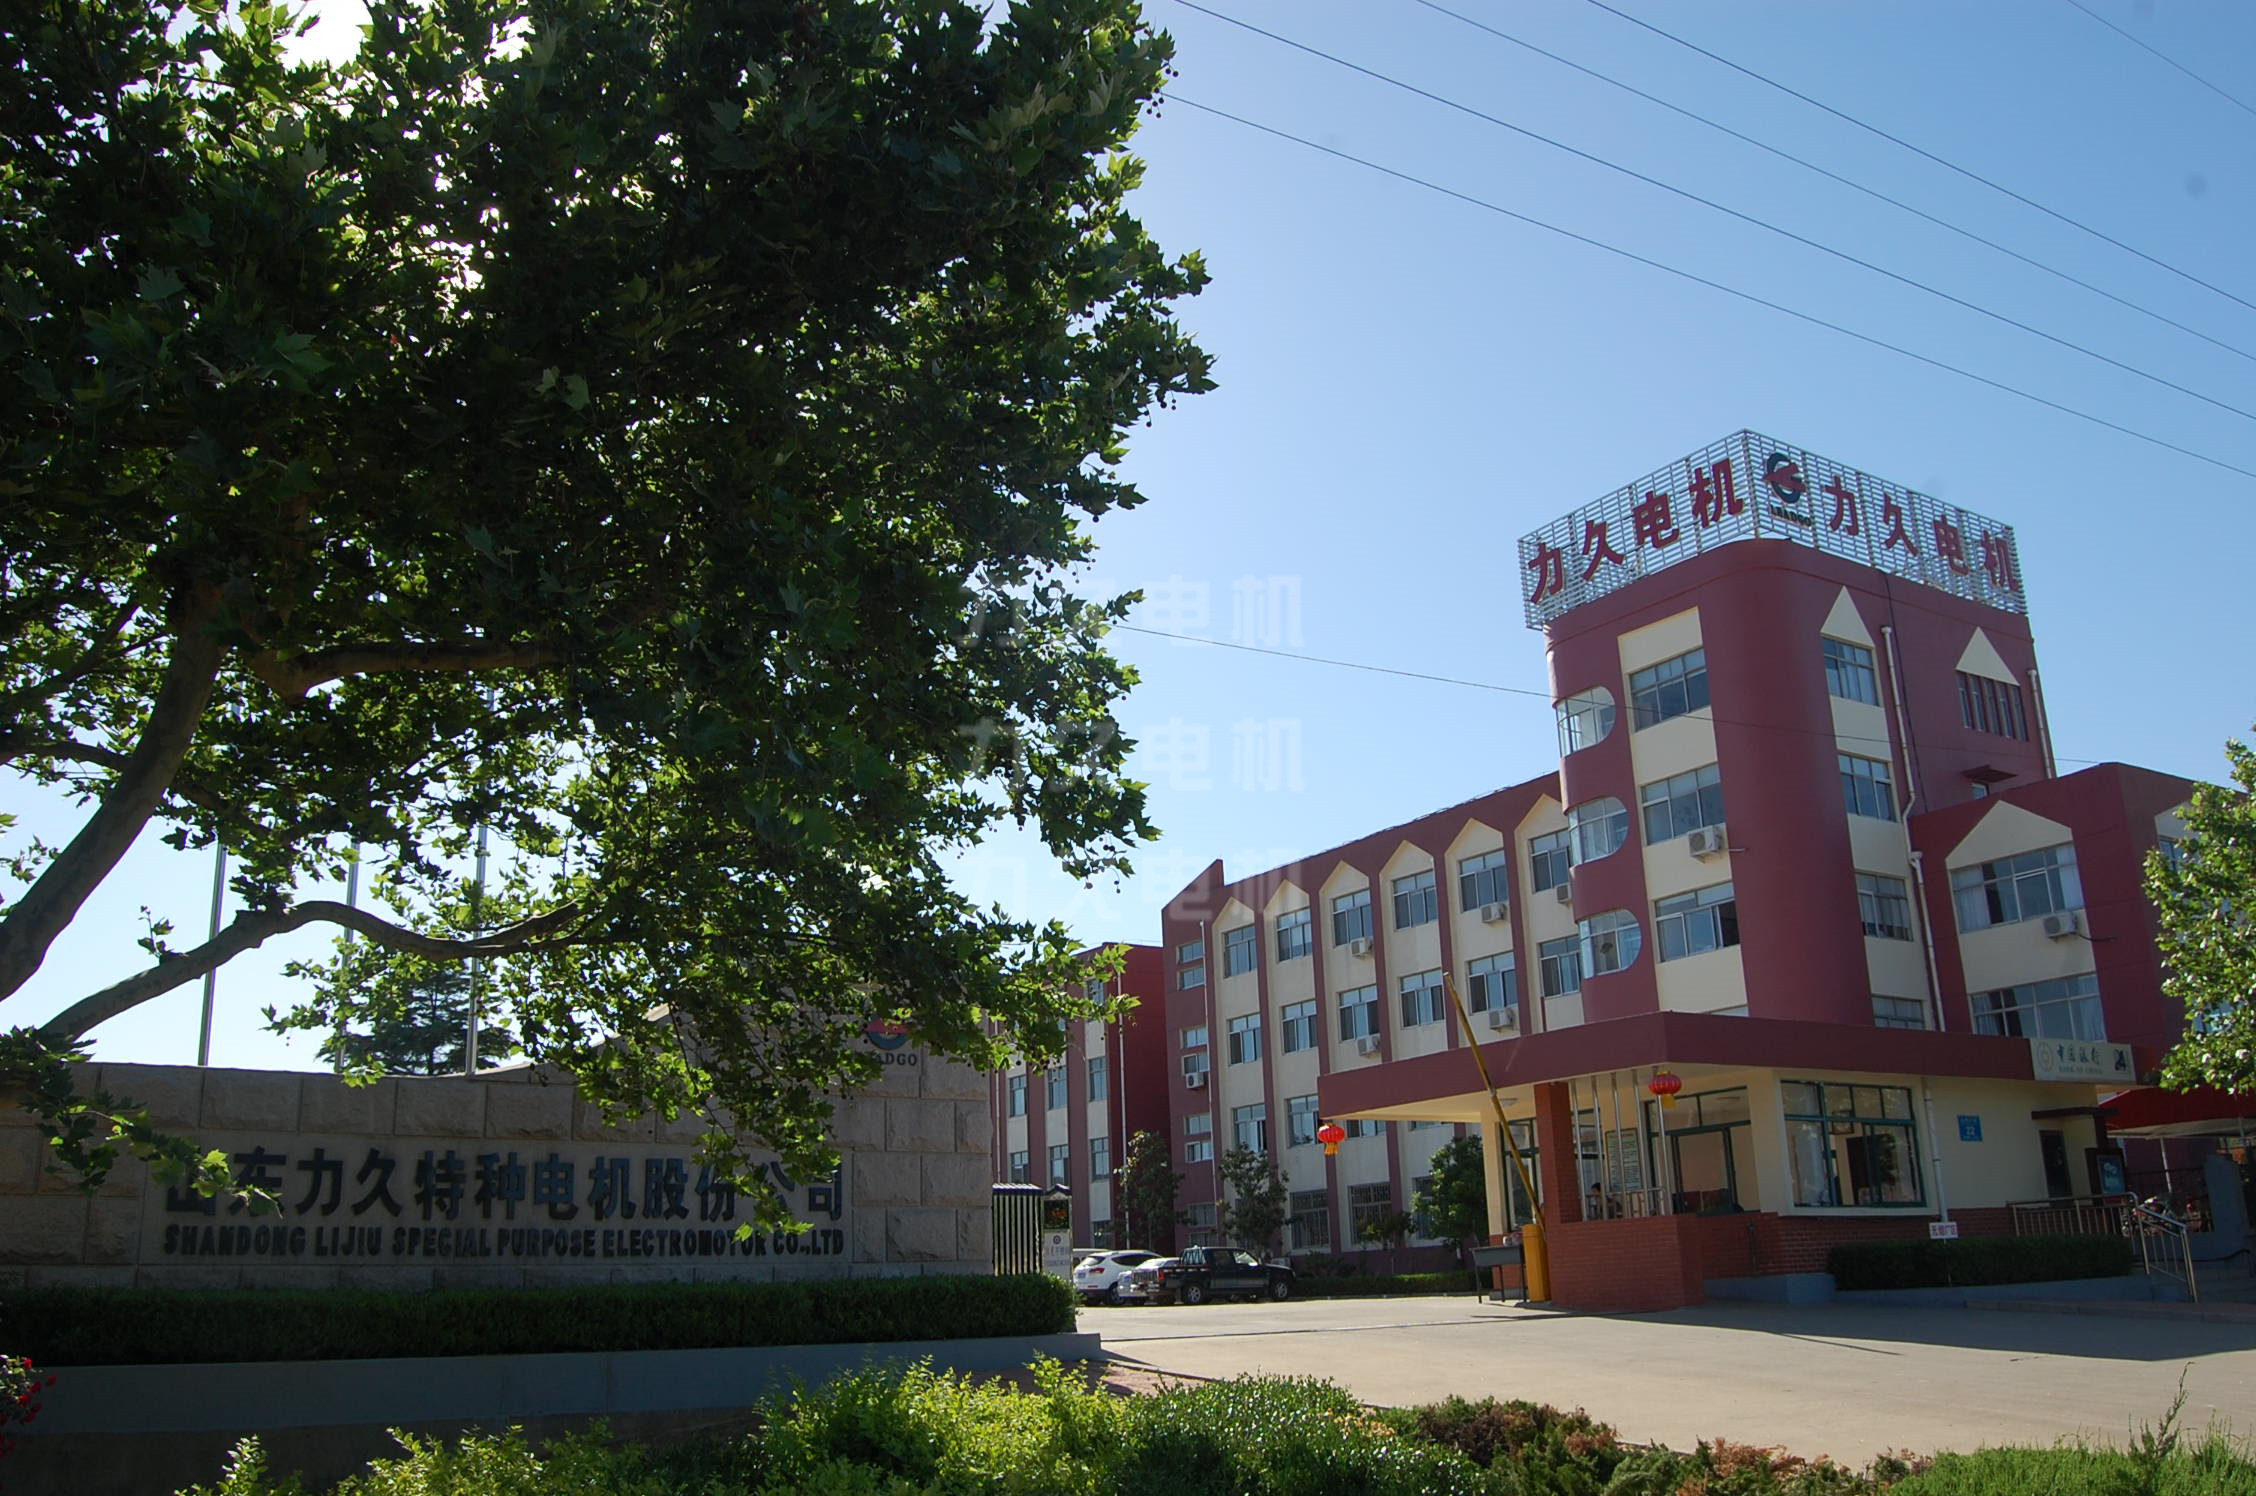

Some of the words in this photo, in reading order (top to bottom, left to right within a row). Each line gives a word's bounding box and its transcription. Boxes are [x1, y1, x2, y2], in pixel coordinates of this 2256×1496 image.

[1528, 458, 1744, 604] 力久电机
[1769, 504, 1812, 527] LEADGO
[1823, 476, 2021, 592] 力久电机
[875, 1052, 918, 1066] ADGO
[164, 1224, 306, 1257] SHANDONG
[315, 1226, 382, 1256] LIJIU
[392, 1227, 491, 1258] SPECIAL
[498, 1229, 596, 1257] PURPOSE
[603, 1229, 766, 1257] ELECTROMOTOR
